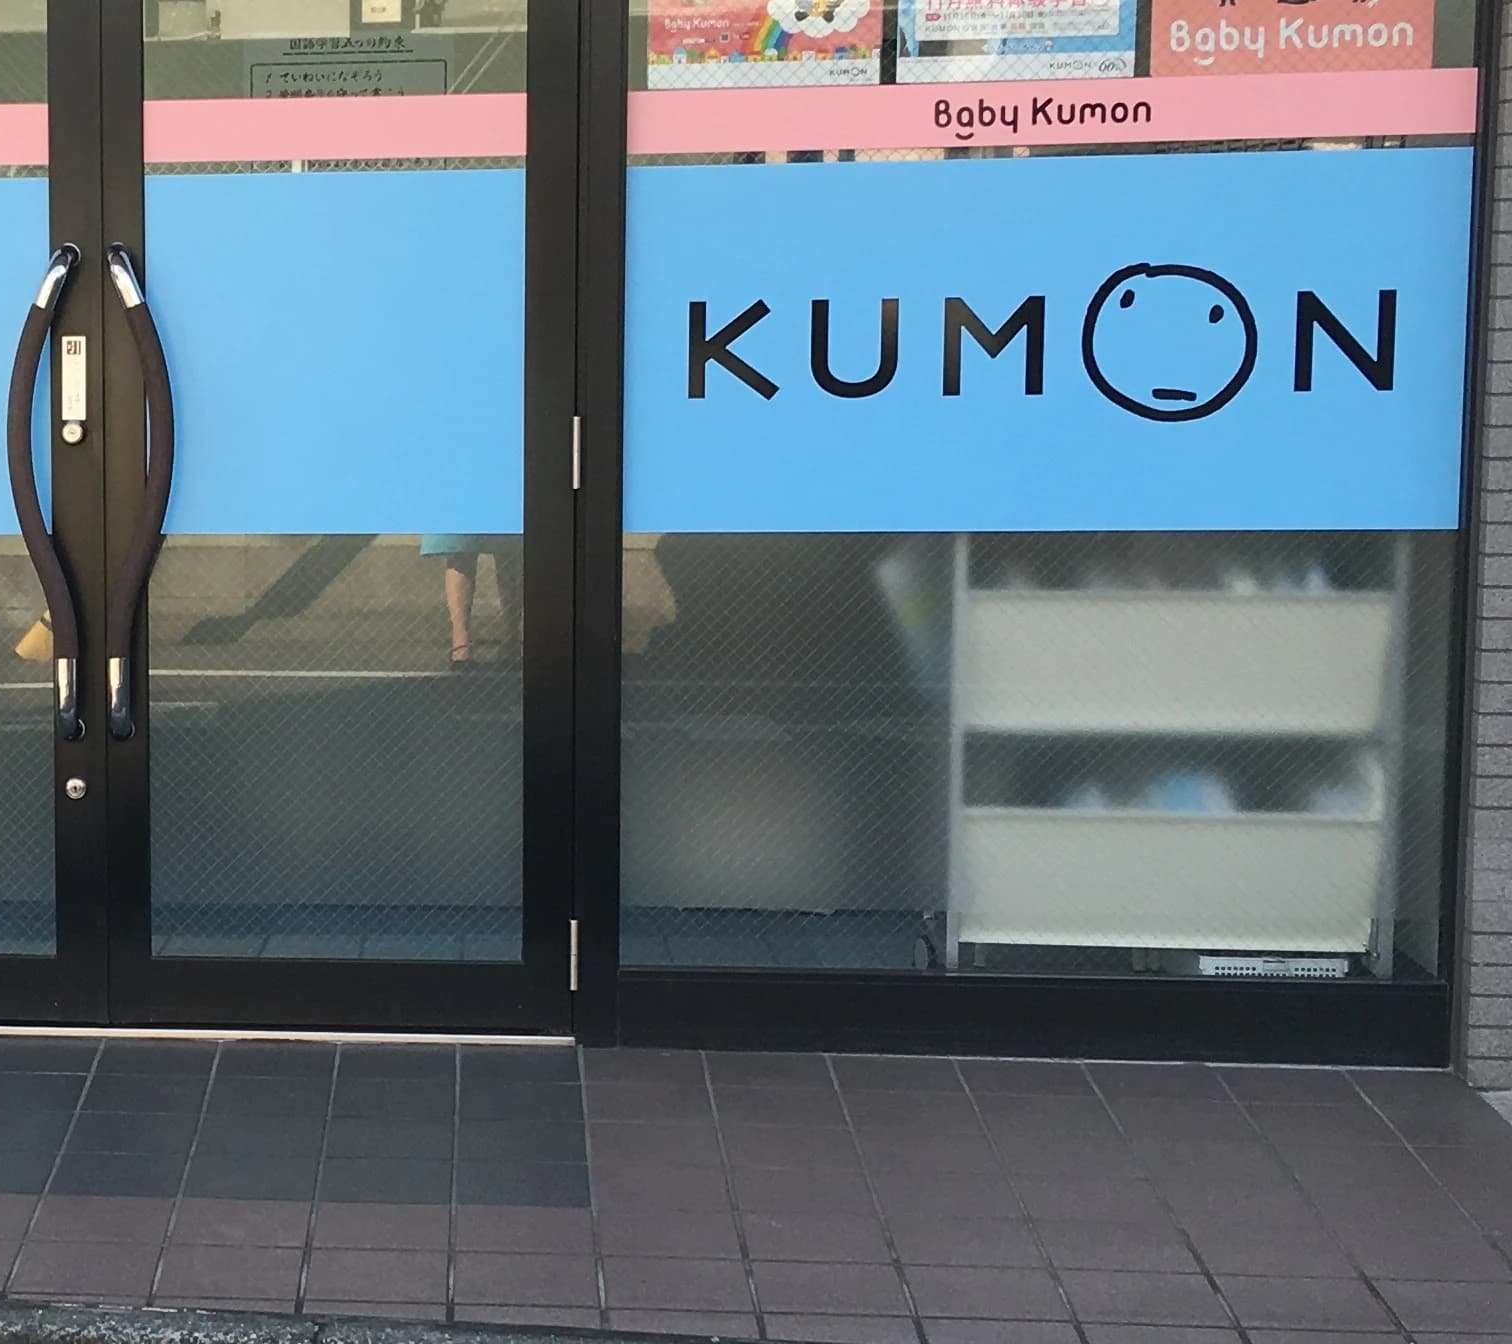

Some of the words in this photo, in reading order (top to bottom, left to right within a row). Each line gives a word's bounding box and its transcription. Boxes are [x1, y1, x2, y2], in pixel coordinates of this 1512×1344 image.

[1169, 19, 1265, 66] Baby
[1278, 17, 1414, 49] Kumon
[934, 98, 1019, 140] Baby
[1031, 97, 1152, 126] Kumon
[688, 262, 1397, 422] KUMON
